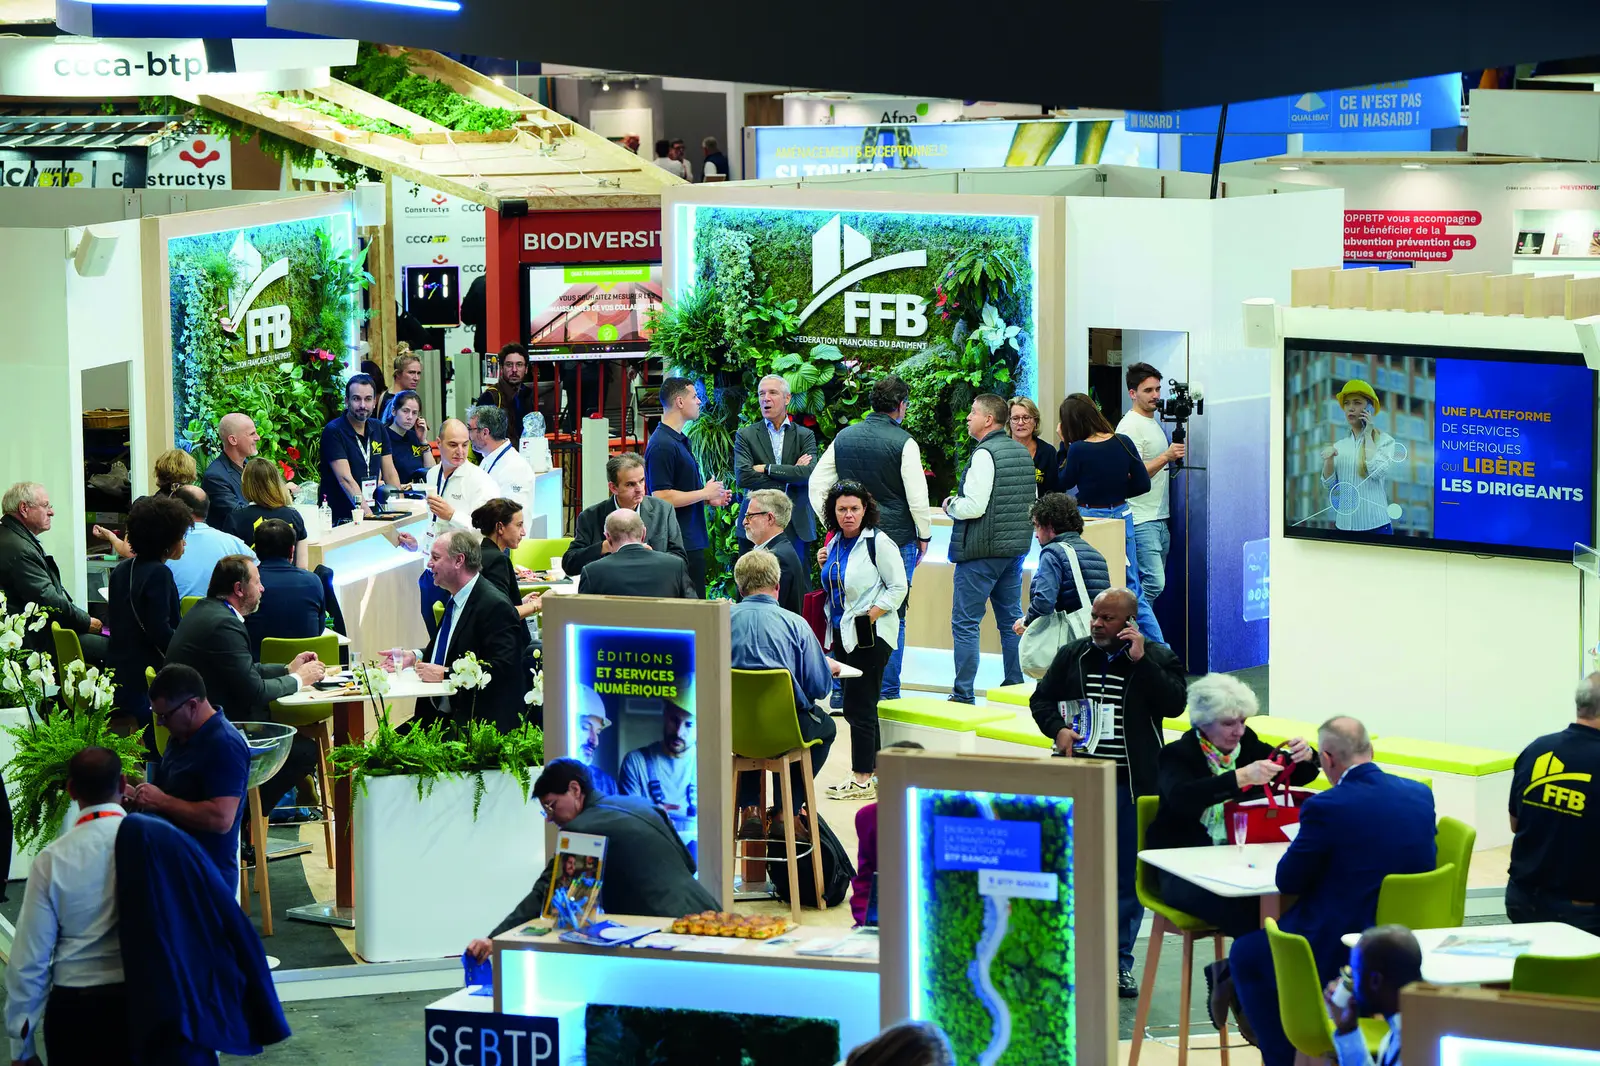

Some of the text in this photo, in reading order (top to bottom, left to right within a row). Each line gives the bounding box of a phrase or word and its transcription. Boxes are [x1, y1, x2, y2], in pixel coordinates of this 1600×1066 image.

[54, 51, 202, 82] ccca-btp
[1340, 92, 1422, 110] CE N'EST PAS
[880, 110, 918, 124] Afpa
[1139, 114, 1172, 128] HASARD
[1176, 114, 1180, 130] !
[1291, 114, 1330, 122] QUALIBAT
[1340, 111, 1420, 128] UN HASARD !
[776, 144, 948, 158] AMÉNAGEMENTS EXCEPTIONNELS
[112, 172, 226, 189] Cstructys
[1413, 216, 1476, 225] accompagne
[1363, 225, 1414, 235] bénéficier
[1416, 226, 1428, 235] de
[1431, 226, 1440, 235] la
[524, 230, 662, 250] BIODIVERSIT
[1396, 238, 1450, 248] prévention
[1453, 238, 1471, 247] des
[1376, 250, 1447, 260] ergonomiques
[844, 292, 928, 336] FFB
[246, 305, 292, 354] FFB
[839, 338, 878, 348] FRANÇAISE
[1442, 406, 1552, 422] UNE PLATEFORME
[1442, 423, 1520, 438] DE SERVICES
[1442, 440, 1521, 454] NUMÉRIQUES
[1442, 456, 1536, 477] QUI LIBÈRE
[1442, 478, 1584, 502] LES DIRIGEANTS
[597, 648, 673, 664] ÉDITIONS
[596, 667, 674, 682] ET SERVICES
[594, 681, 677, 698] NUMÉRIQUES
[1542, 783, 1586, 811] FFB
[428, 1024, 552, 1066] SEBTP
